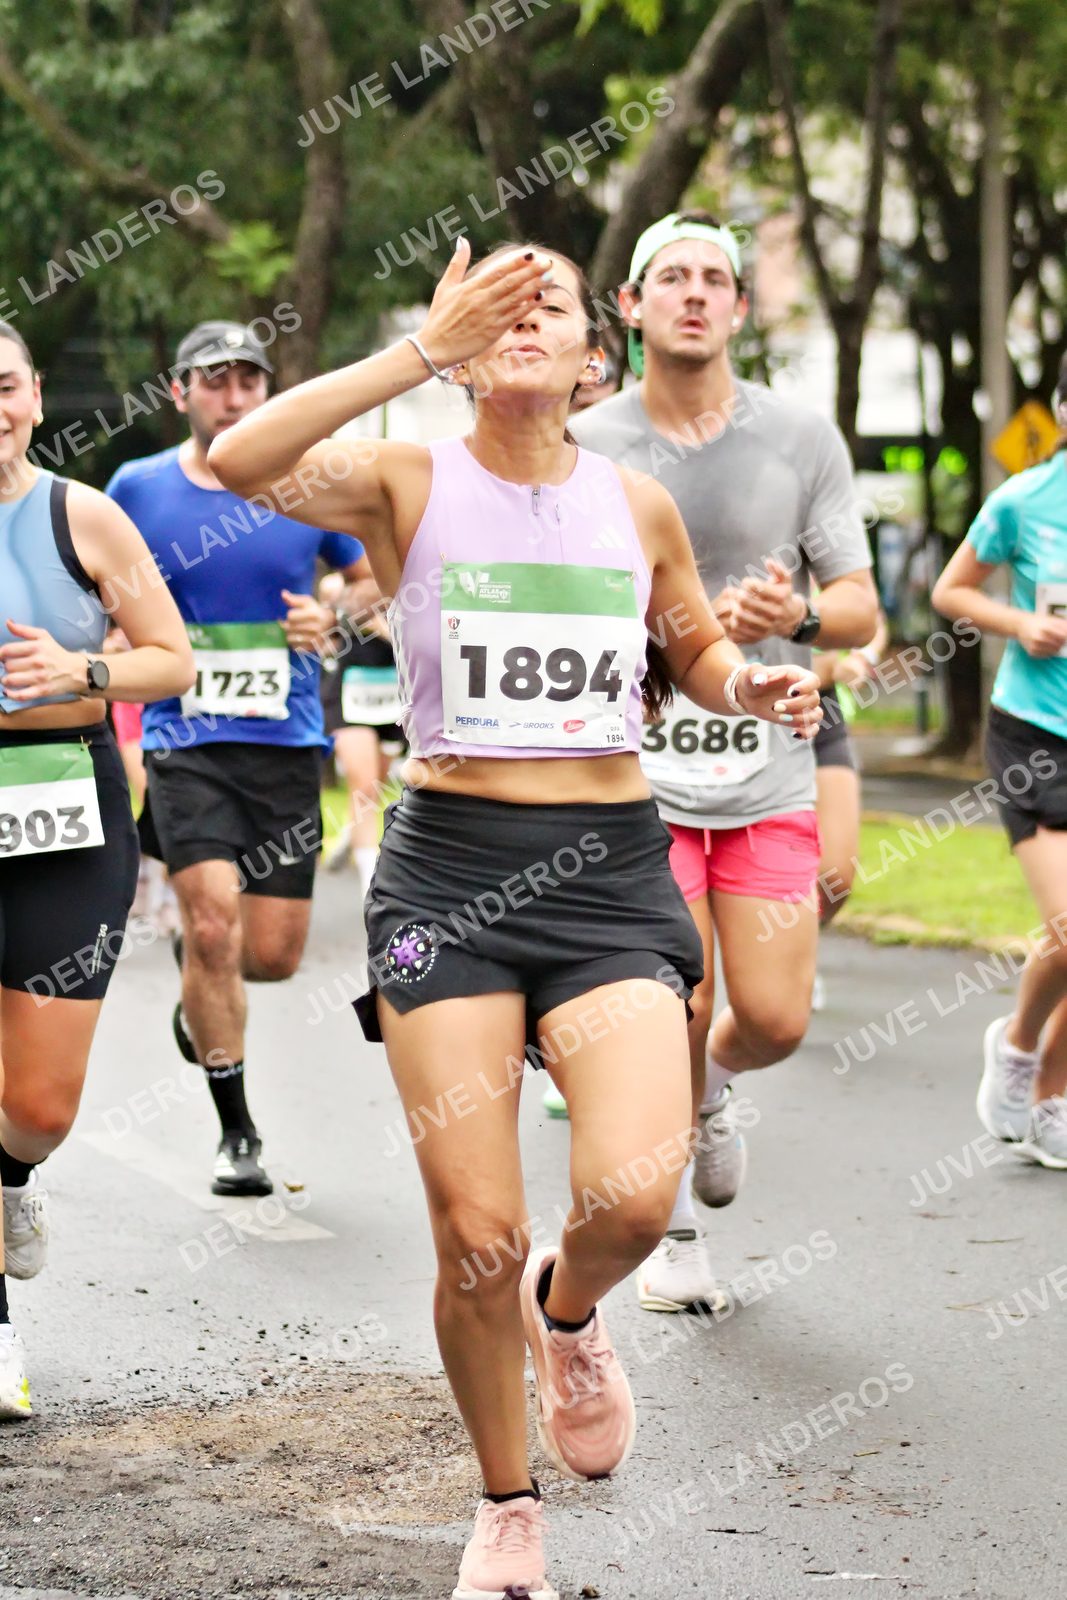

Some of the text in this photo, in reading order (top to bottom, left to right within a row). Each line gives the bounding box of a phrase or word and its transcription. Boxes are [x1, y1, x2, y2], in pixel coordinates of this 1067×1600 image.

[195, 670, 280, 697] 1723
[460, 645, 622, 702] 1894
[455, 716, 500, 727] PERDURA
[641, 718, 759, 754] 3686
[606, 734, 625, 743] 1894
[0, 806, 90, 852] 903
